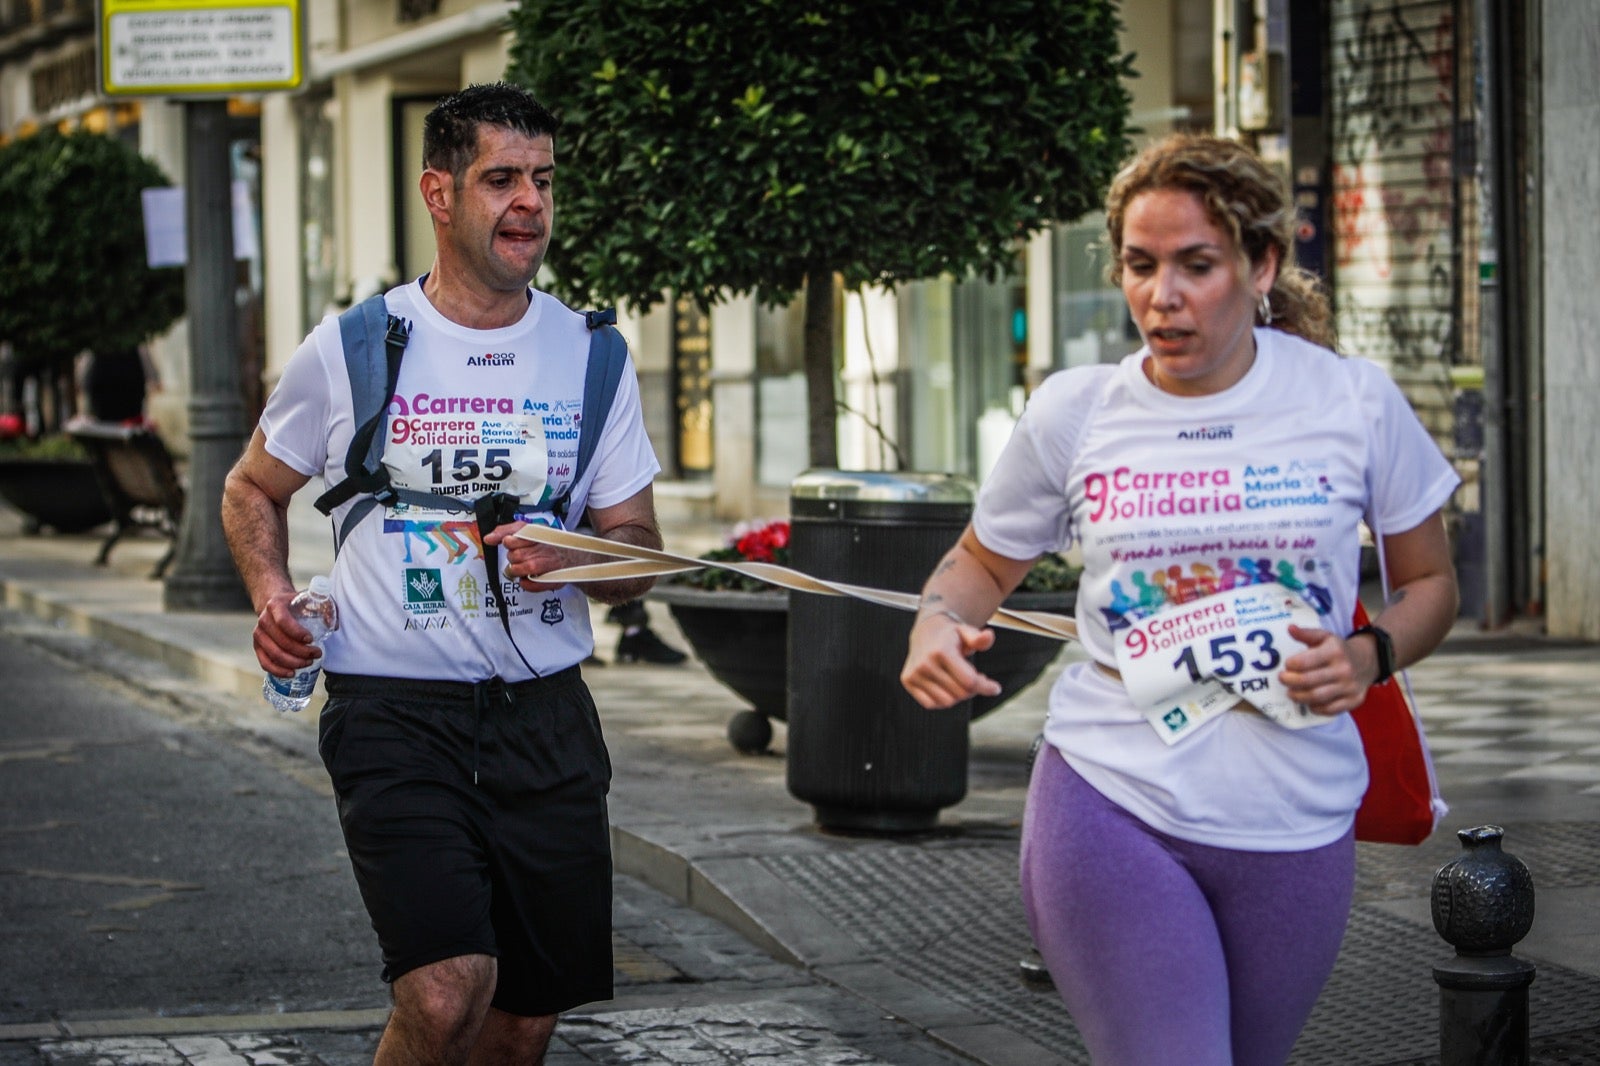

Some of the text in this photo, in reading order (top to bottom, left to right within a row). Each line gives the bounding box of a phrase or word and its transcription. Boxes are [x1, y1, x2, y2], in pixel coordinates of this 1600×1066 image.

[467, 354, 515, 366] Altium
[412, 393, 514, 415] Carrera
[523, 399, 549, 412] Ave
[391, 418, 475, 445] 9 Carrera
[481, 420, 502, 428] Ave
[411, 431, 480, 446] Solidaria
[481, 436, 527, 446] Granada
[544, 428, 578, 441] anada
[421, 448, 513, 485] 155
[556, 463, 570, 478] alto
[1244, 464, 1280, 478] Ave
[431, 482, 500, 496] SUPER DANI
[1085, 466, 1230, 523] 9 Carrera
[1110, 490, 1241, 521] Solidaria
[1245, 492, 1329, 510] Granada
[1169, 539, 1224, 557] siempre
[1228, 533, 1270, 551] hacia
[1275, 534, 1289, 550] lo
[423, 602, 447, 610] RURAL
[485, 595, 519, 608] RAL
[1234, 596, 1257, 606] Ave
[403, 616, 453, 631] ANAYA
[1237, 611, 1293, 626] Granada
[1125, 602, 1226, 660] 9 Carrera
[1151, 614, 1236, 653] Solidaria
[1173, 629, 1281, 684] 153
